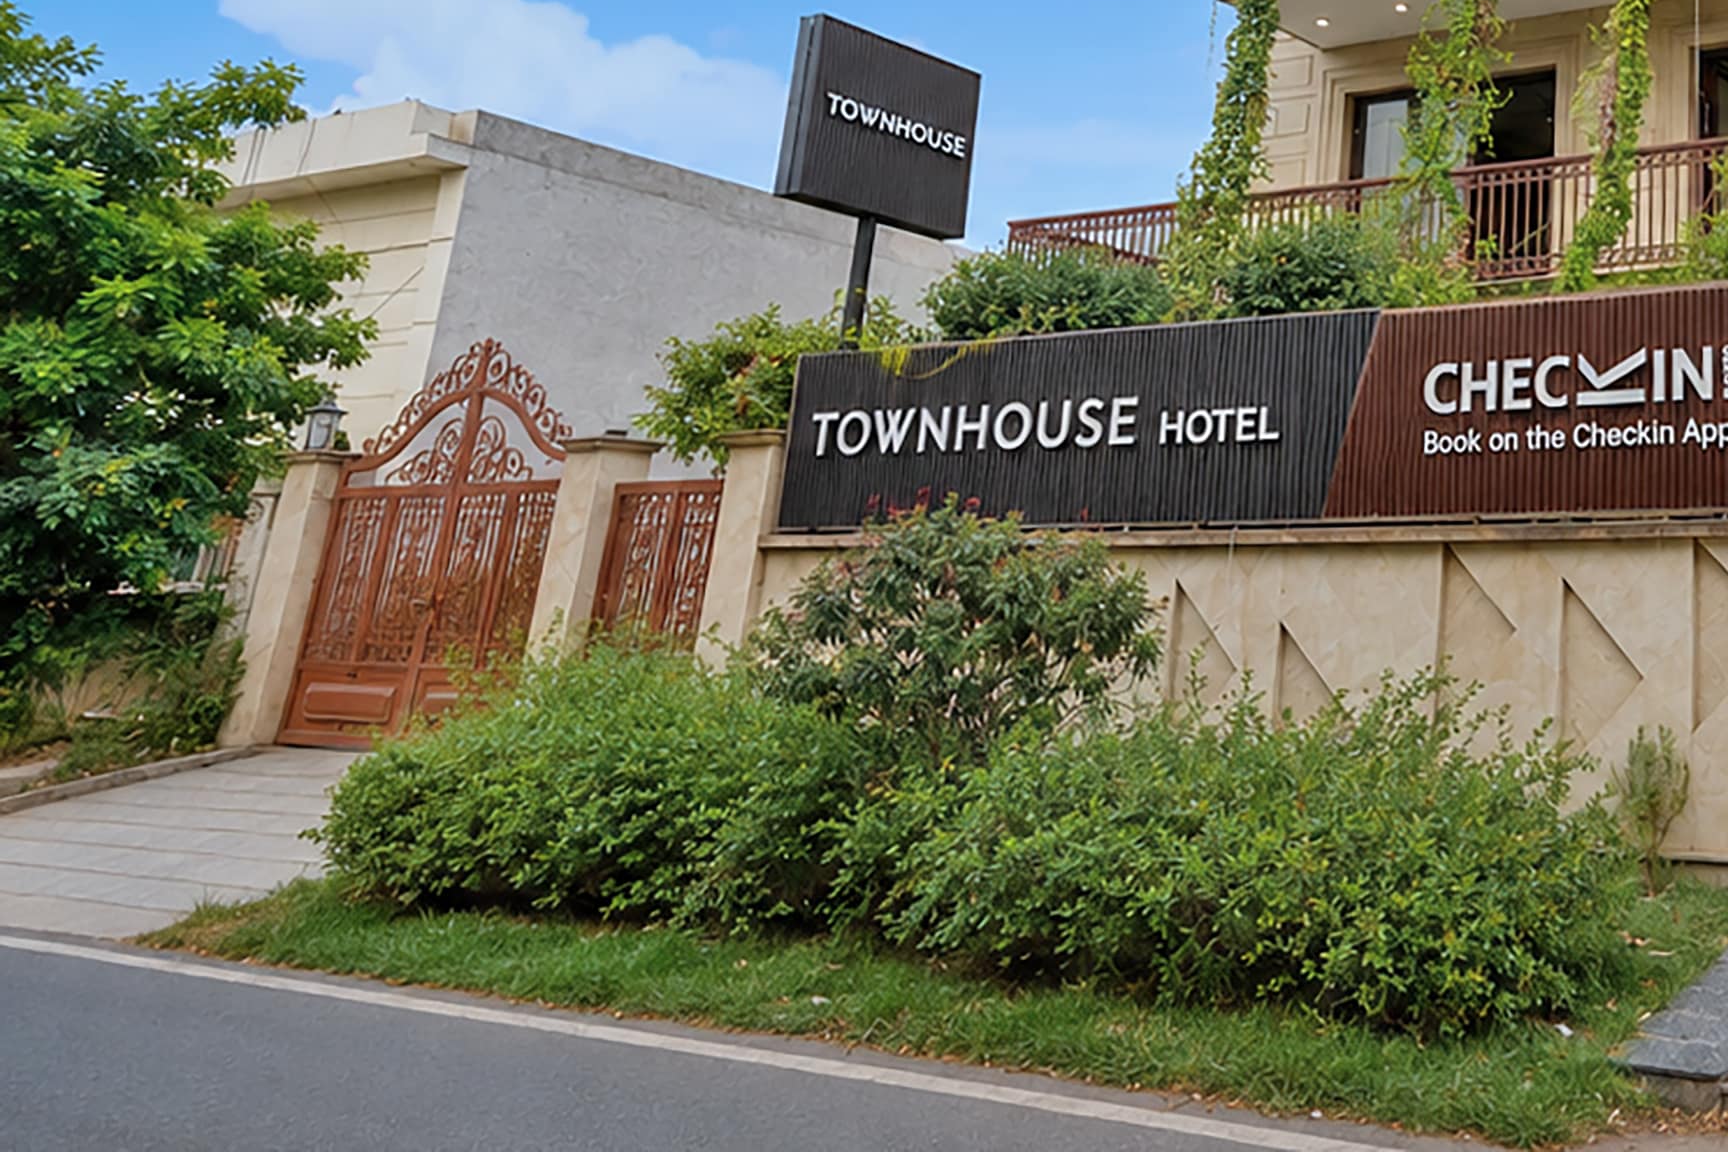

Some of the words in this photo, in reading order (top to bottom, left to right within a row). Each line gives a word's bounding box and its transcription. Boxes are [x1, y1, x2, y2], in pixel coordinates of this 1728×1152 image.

[827, 92, 966, 158] TOWNHOUSE
[1424, 345, 1714, 415] CHECKIN
[812, 396, 1139, 456] TOWNHOUSE
[1159, 407, 1280, 445] HOTEL
[1423, 428, 1482, 455] Book
[1489, 431, 1519, 451] on
[1526, 424, 1566, 450] the
[1572, 419, 1675, 448] Checkin
